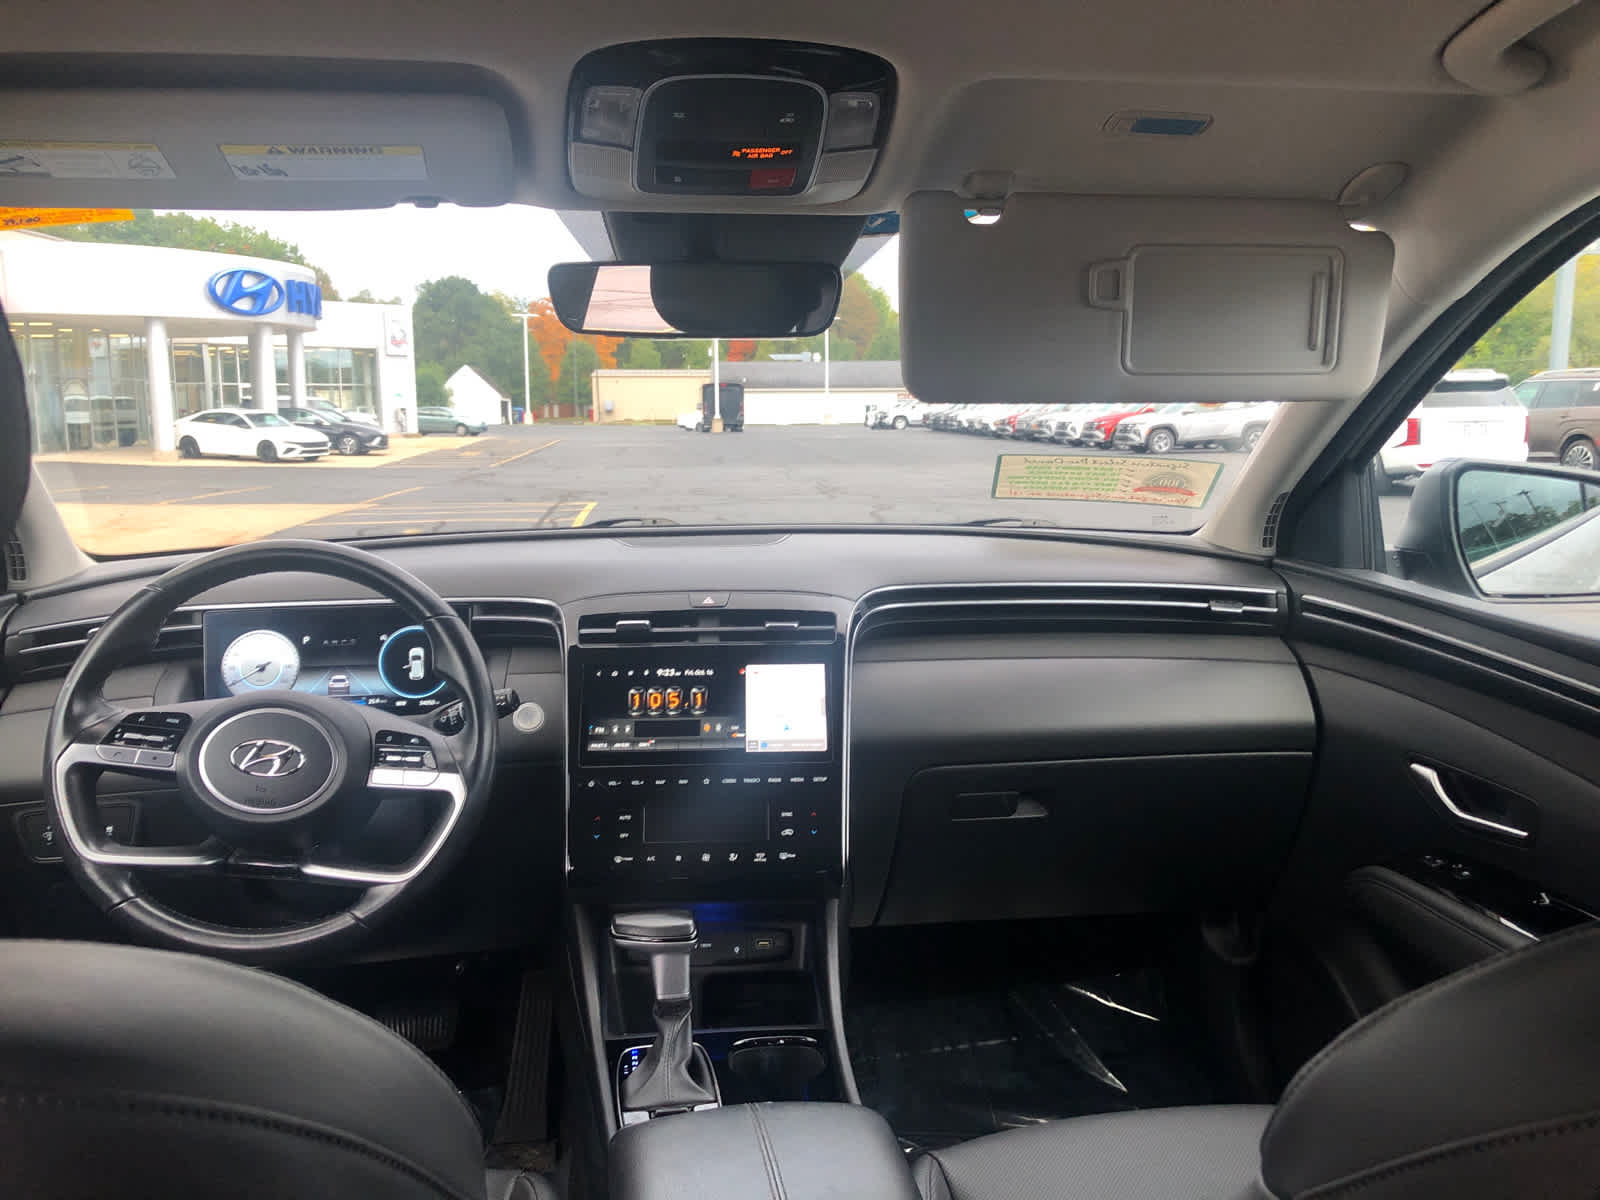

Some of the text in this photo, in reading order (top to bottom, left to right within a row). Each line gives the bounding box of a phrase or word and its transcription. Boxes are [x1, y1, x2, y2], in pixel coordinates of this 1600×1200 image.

[287, 144, 384, 155] WARNING
[286, 280, 322, 320] HY
[632, 691, 703, 710] 105.1
